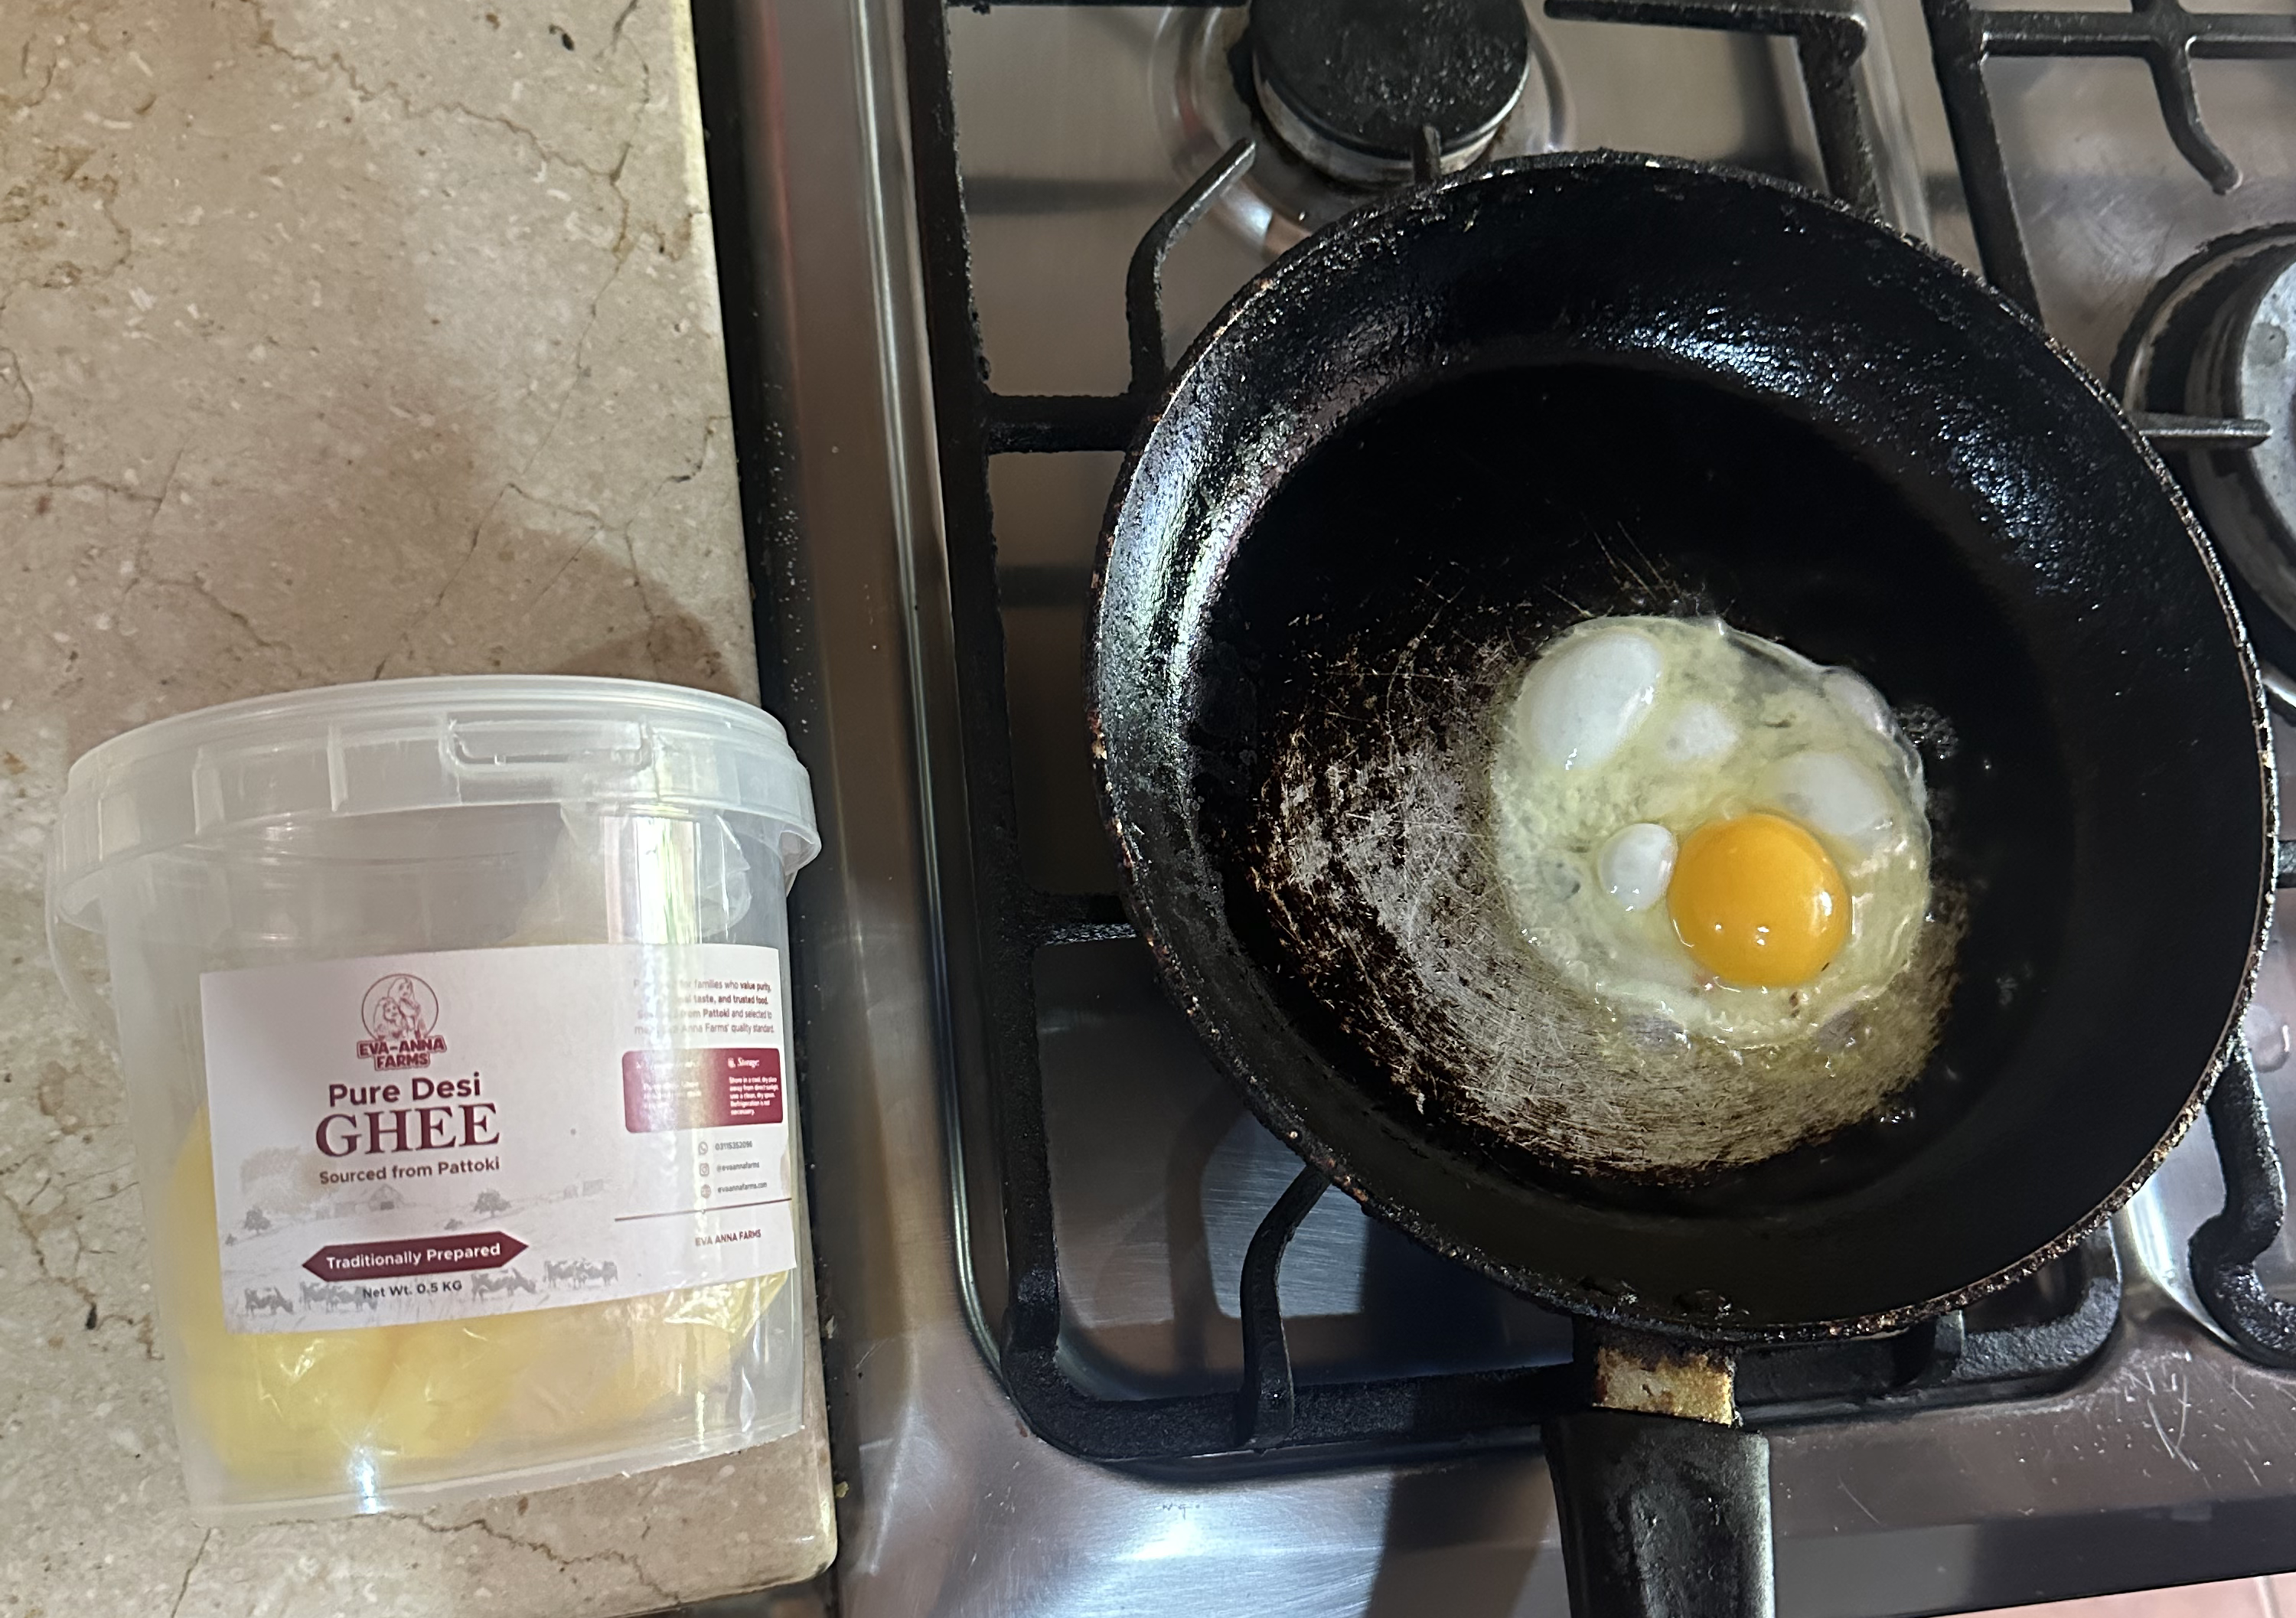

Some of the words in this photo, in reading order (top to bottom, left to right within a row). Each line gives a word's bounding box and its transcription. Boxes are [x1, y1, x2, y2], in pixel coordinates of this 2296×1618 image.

[694, 979, 722, 989] families
[725, 980, 739, 990] who
[740, 980, 755, 990] value
[693, 994, 716, 1004] taste,
[719, 995, 732, 1003] and
[733, 995, 755, 1004] trusted
[703, 1008, 729, 1018] Pattoki
[732, 1010, 744, 1018] and
[731, 1023, 752, 1035] quality
[360, 1037, 445, 1056] EVA-ANNA
[377, 1053, 429, 1068] FARMS
[329, 1083, 401, 1107] Pure
[412, 1072, 481, 1101] Desi
[315, 1102, 501, 1157] GHEE
[320, 1166, 387, 1185] Sourced
[392, 1164, 432, 1179] from
[438, 1156, 500, 1174] Pattoki
[696, 1235, 713, 1247] EVA
[715, 1232, 738, 1244] ANNA
[739, 1229, 762, 1240] FARMS
[326, 1250, 422, 1271] Traditionally
[426, 1242, 501, 1264] Prepared
[363, 1287, 385, 1299] Net
[390, 1285, 413, 1296] Wt.
[416, 1283, 439, 1294] 0.5
[442, 1280, 462, 1291] KG
